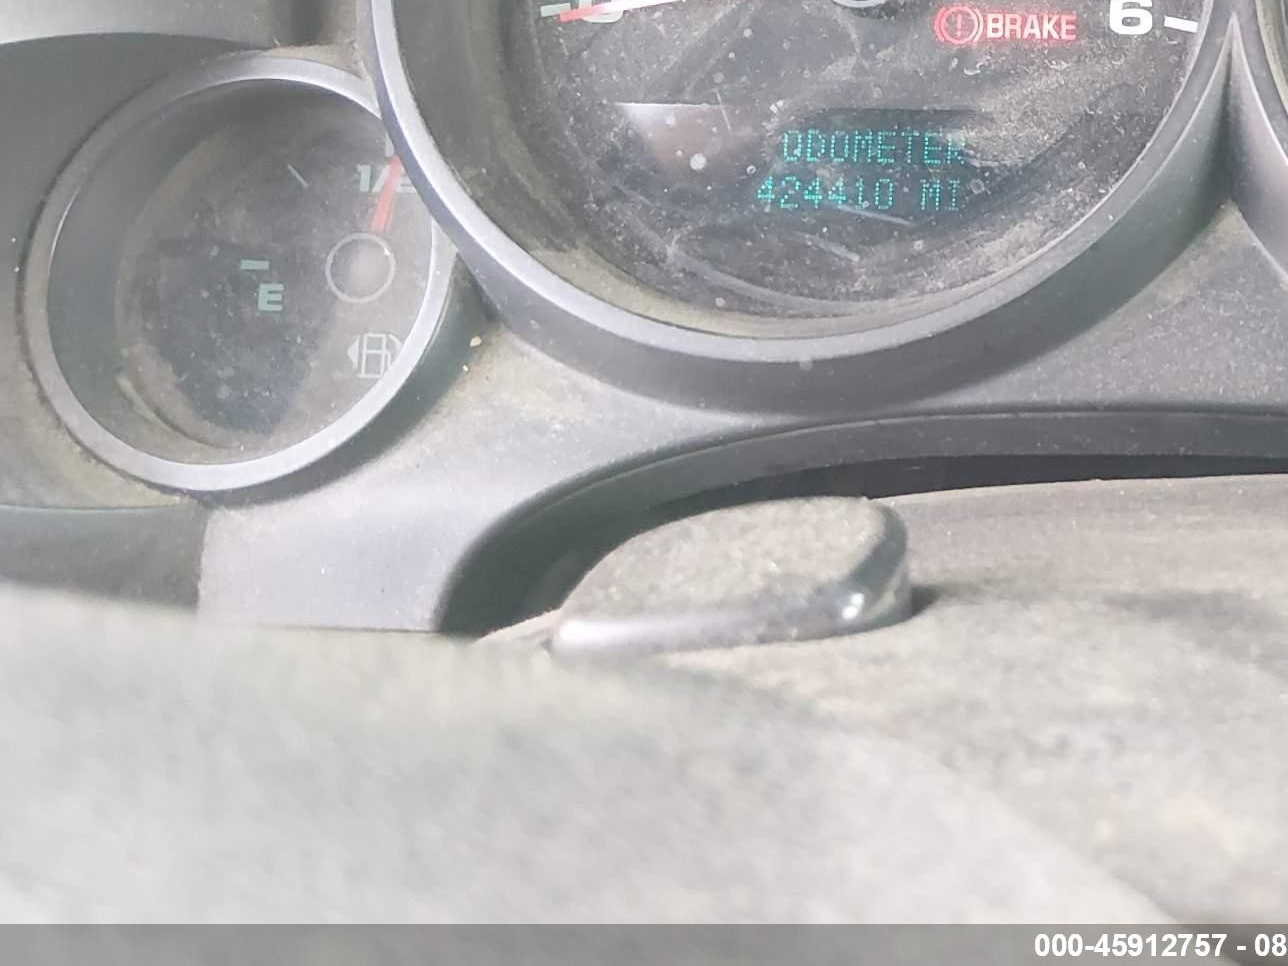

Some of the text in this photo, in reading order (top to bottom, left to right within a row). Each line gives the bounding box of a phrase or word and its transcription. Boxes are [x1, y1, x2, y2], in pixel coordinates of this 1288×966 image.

[987, 14, 1077, 41] BRAKE
[757, 175, 960, 211] 424410 MI
[257, 283, 285, 312] E
